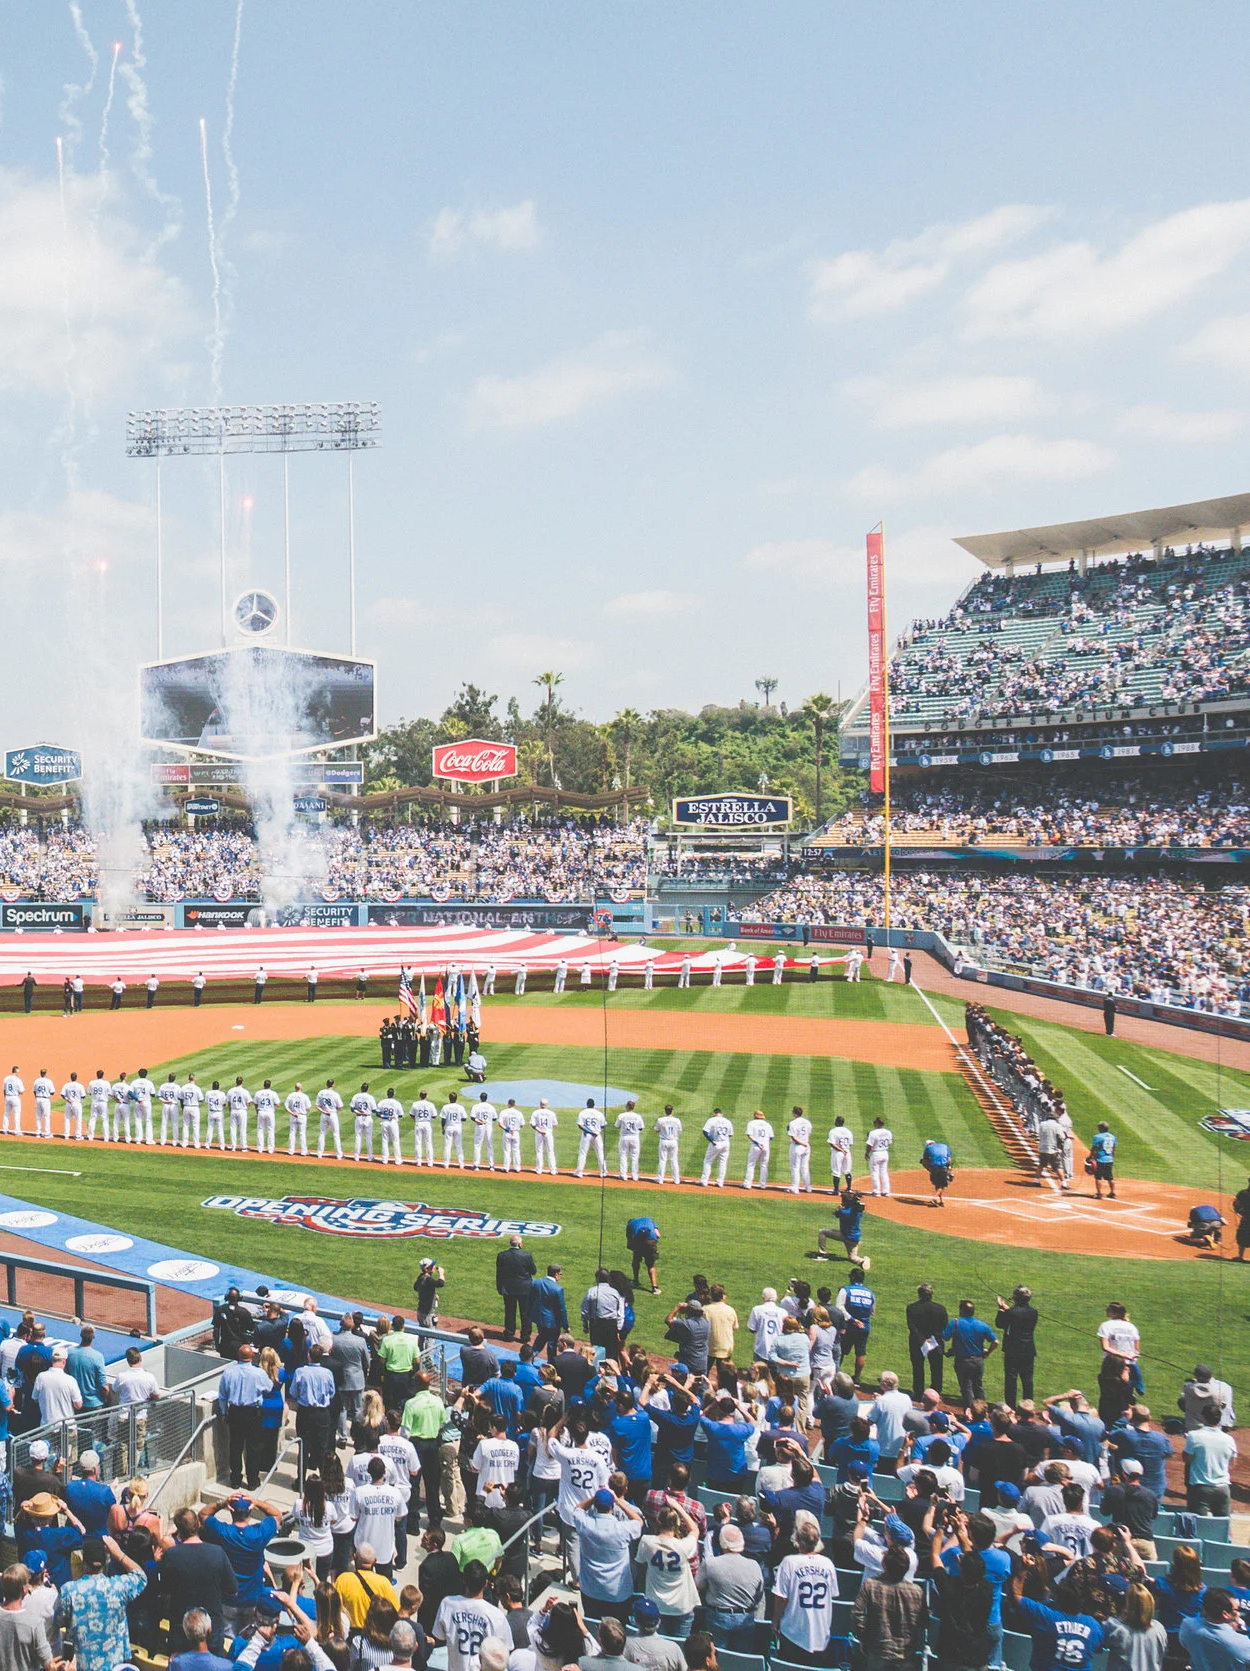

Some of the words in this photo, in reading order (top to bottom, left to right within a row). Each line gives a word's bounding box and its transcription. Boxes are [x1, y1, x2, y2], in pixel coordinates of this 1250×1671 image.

[869, 554, 879, 595] Emirates
[869, 596, 879, 613] Fly
[870, 633, 880, 673] Emirates
[870, 674, 880, 692] Fly
[924, 719, 1013, 732] DODGER
[1030, 710, 1130, 725] STADIUM
[1149, 704, 1200, 717] CLUB
[871, 712, 881, 752] Emirates
[34, 755, 76, 764] SECURITY
[439, 749, 510, 772] Coca-Cola
[871, 753, 881, 771] Fly
[34, 765, 71, 774] BENEFIT
[687, 802, 777, 814] ESTRELLA
[696, 812, 768, 824] JALISCO
[7, 908, 74, 925] Spectrum
[304, 906, 353, 916] SECURITY
[814, 928, 828, 938] Fly
[829, 929, 862, 939] Emirates
[207, 1196, 395, 1222] OPENING
[400, 1213, 558, 1235] SERIES
[767, 1320, 776, 1335] 9
[380, 1446, 406, 1457] DODGERS
[490, 1448, 518, 1458] DODGERS
[490, 1460, 502, 1468] BLUE
[570, 1468, 594, 1490] 22
[364, 1496, 394, 1506] DODGERS
[364, 1507, 378, 1516] BLUE
[650, 1550, 682, 1572] 42
[798, 1582, 827, 1610] 22
[458, 1628, 484, 1656] 22
